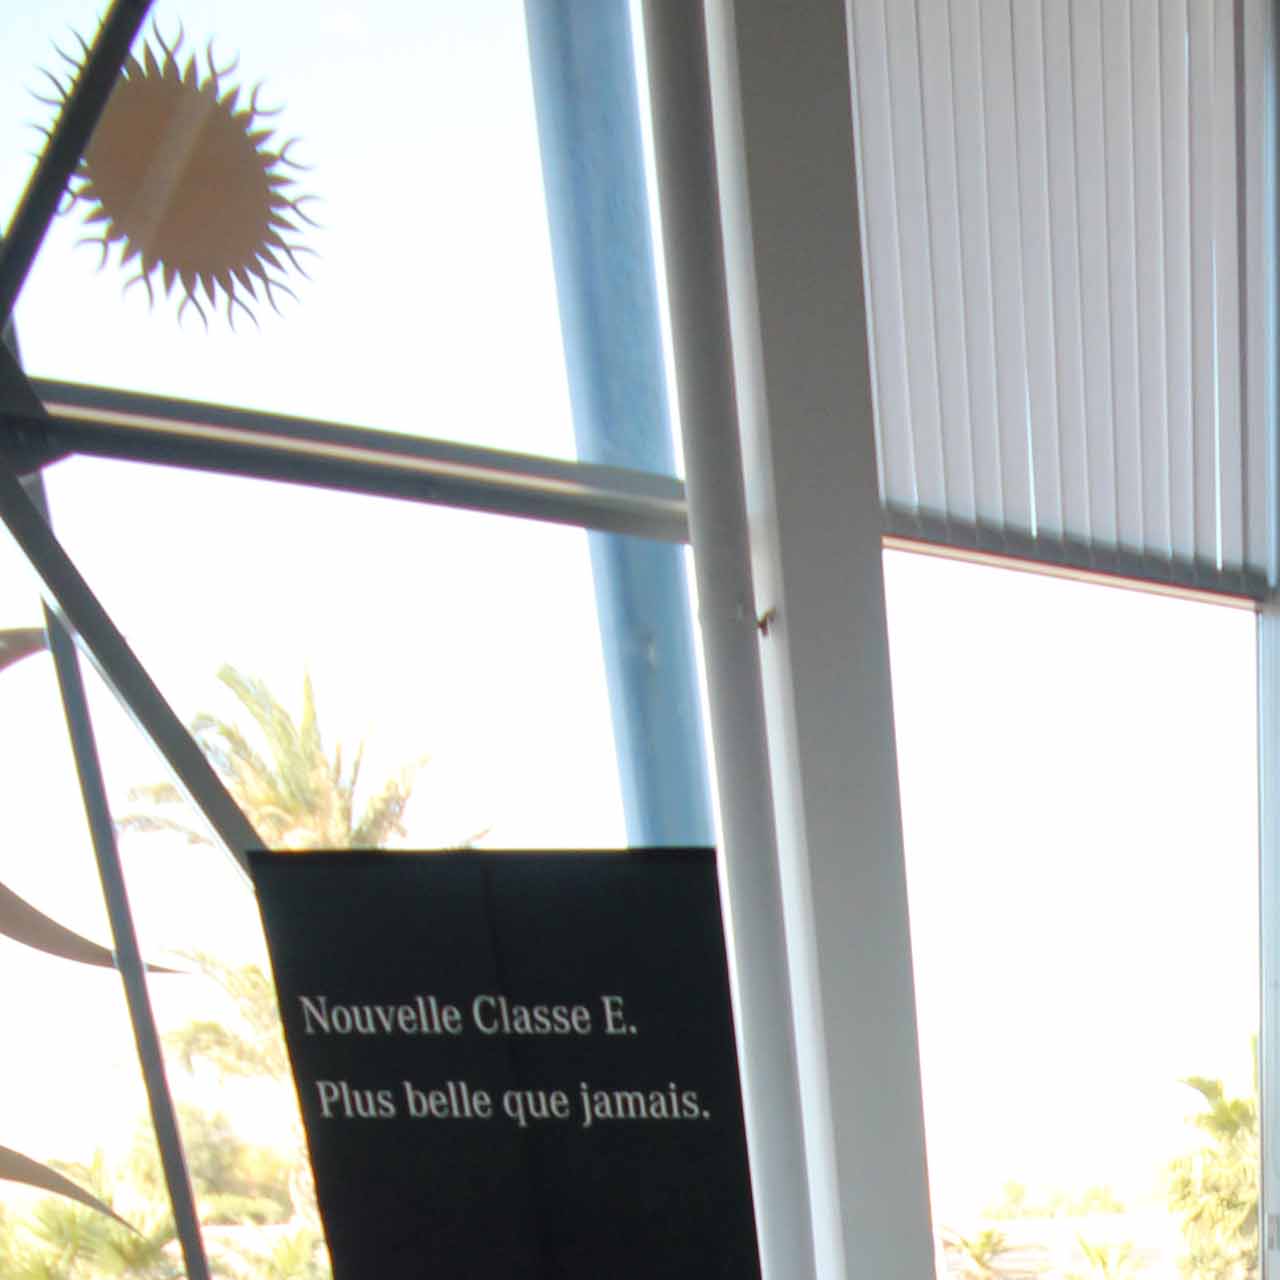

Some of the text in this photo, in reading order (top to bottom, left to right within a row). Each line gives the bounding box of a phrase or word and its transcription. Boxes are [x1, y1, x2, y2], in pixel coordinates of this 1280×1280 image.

[299, 995, 639, 1035] Nouvelle Classe E.
[315, 1080, 711, 1127] Plus belle que jamais.
